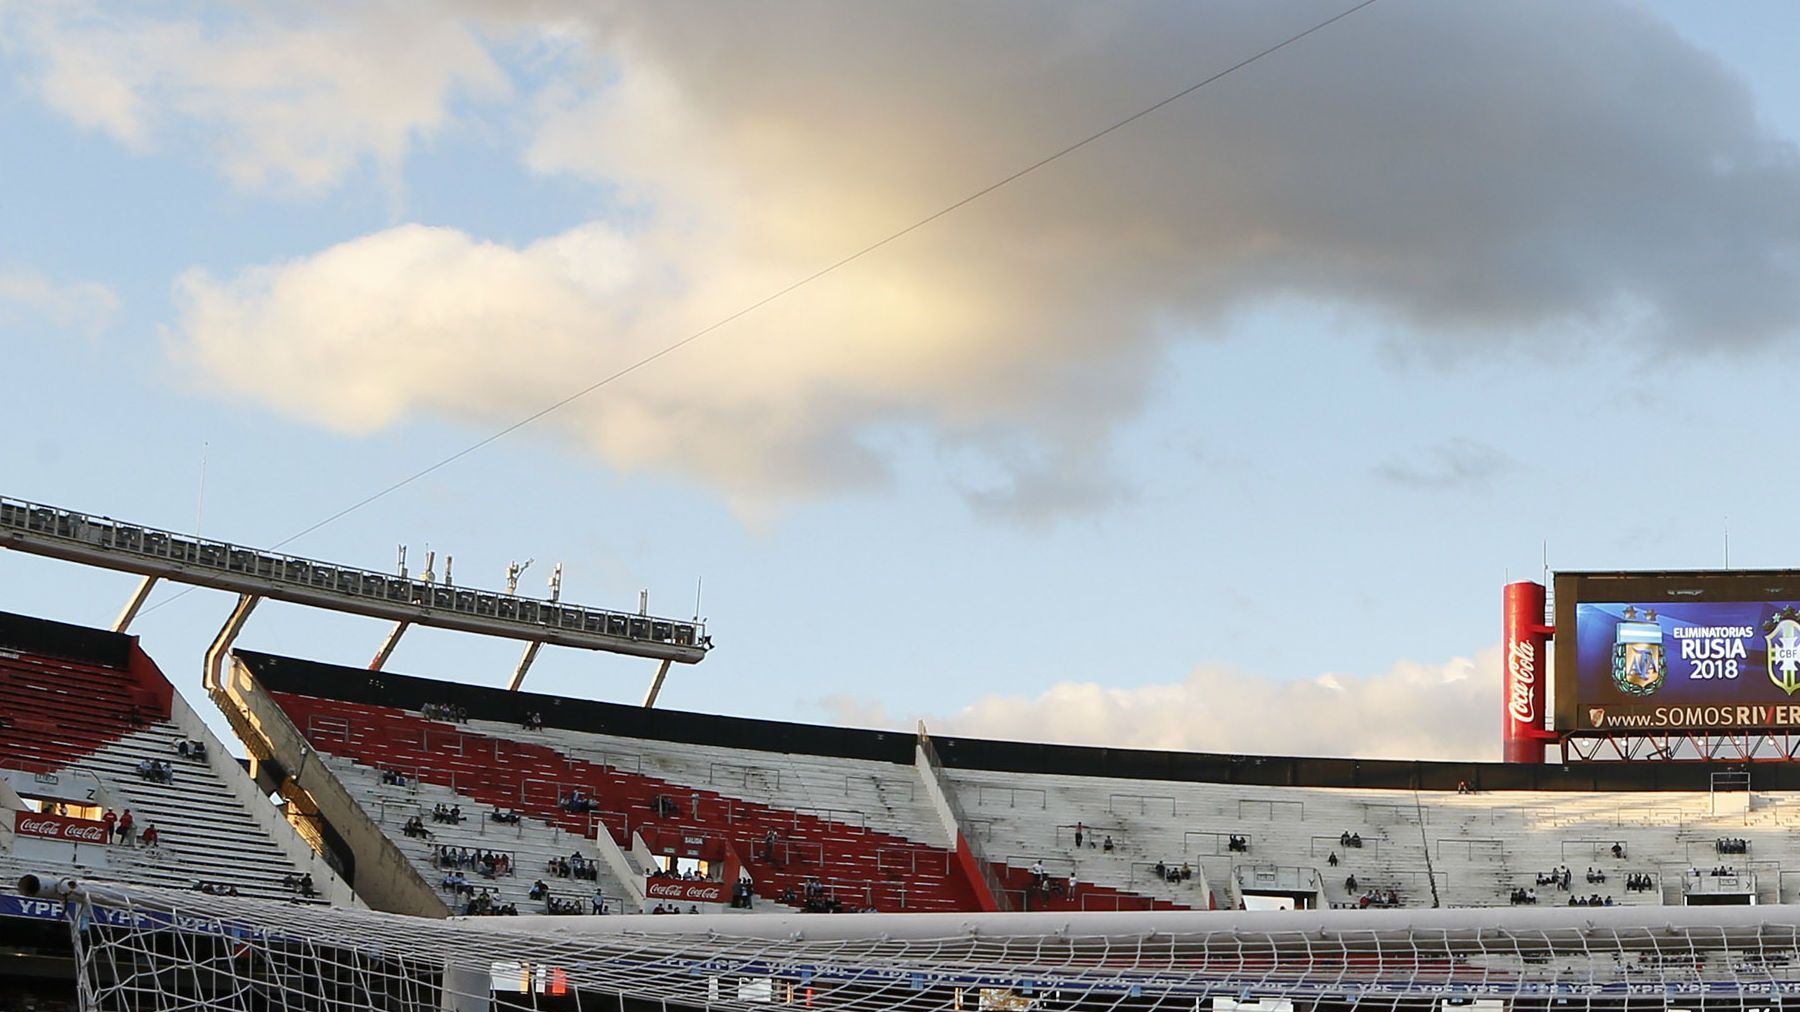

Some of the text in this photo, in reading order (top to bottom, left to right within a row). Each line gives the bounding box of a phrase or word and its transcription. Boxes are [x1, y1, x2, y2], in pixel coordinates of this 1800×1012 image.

[1673, 626, 1753, 639] ELIMINATORIAS
[1681, 639, 1747, 659] RUSIA
[1779, 650, 1797, 658] CBF
[1690, 660, 1739, 679] 2018
[18, 900, 66, 916] YPF
